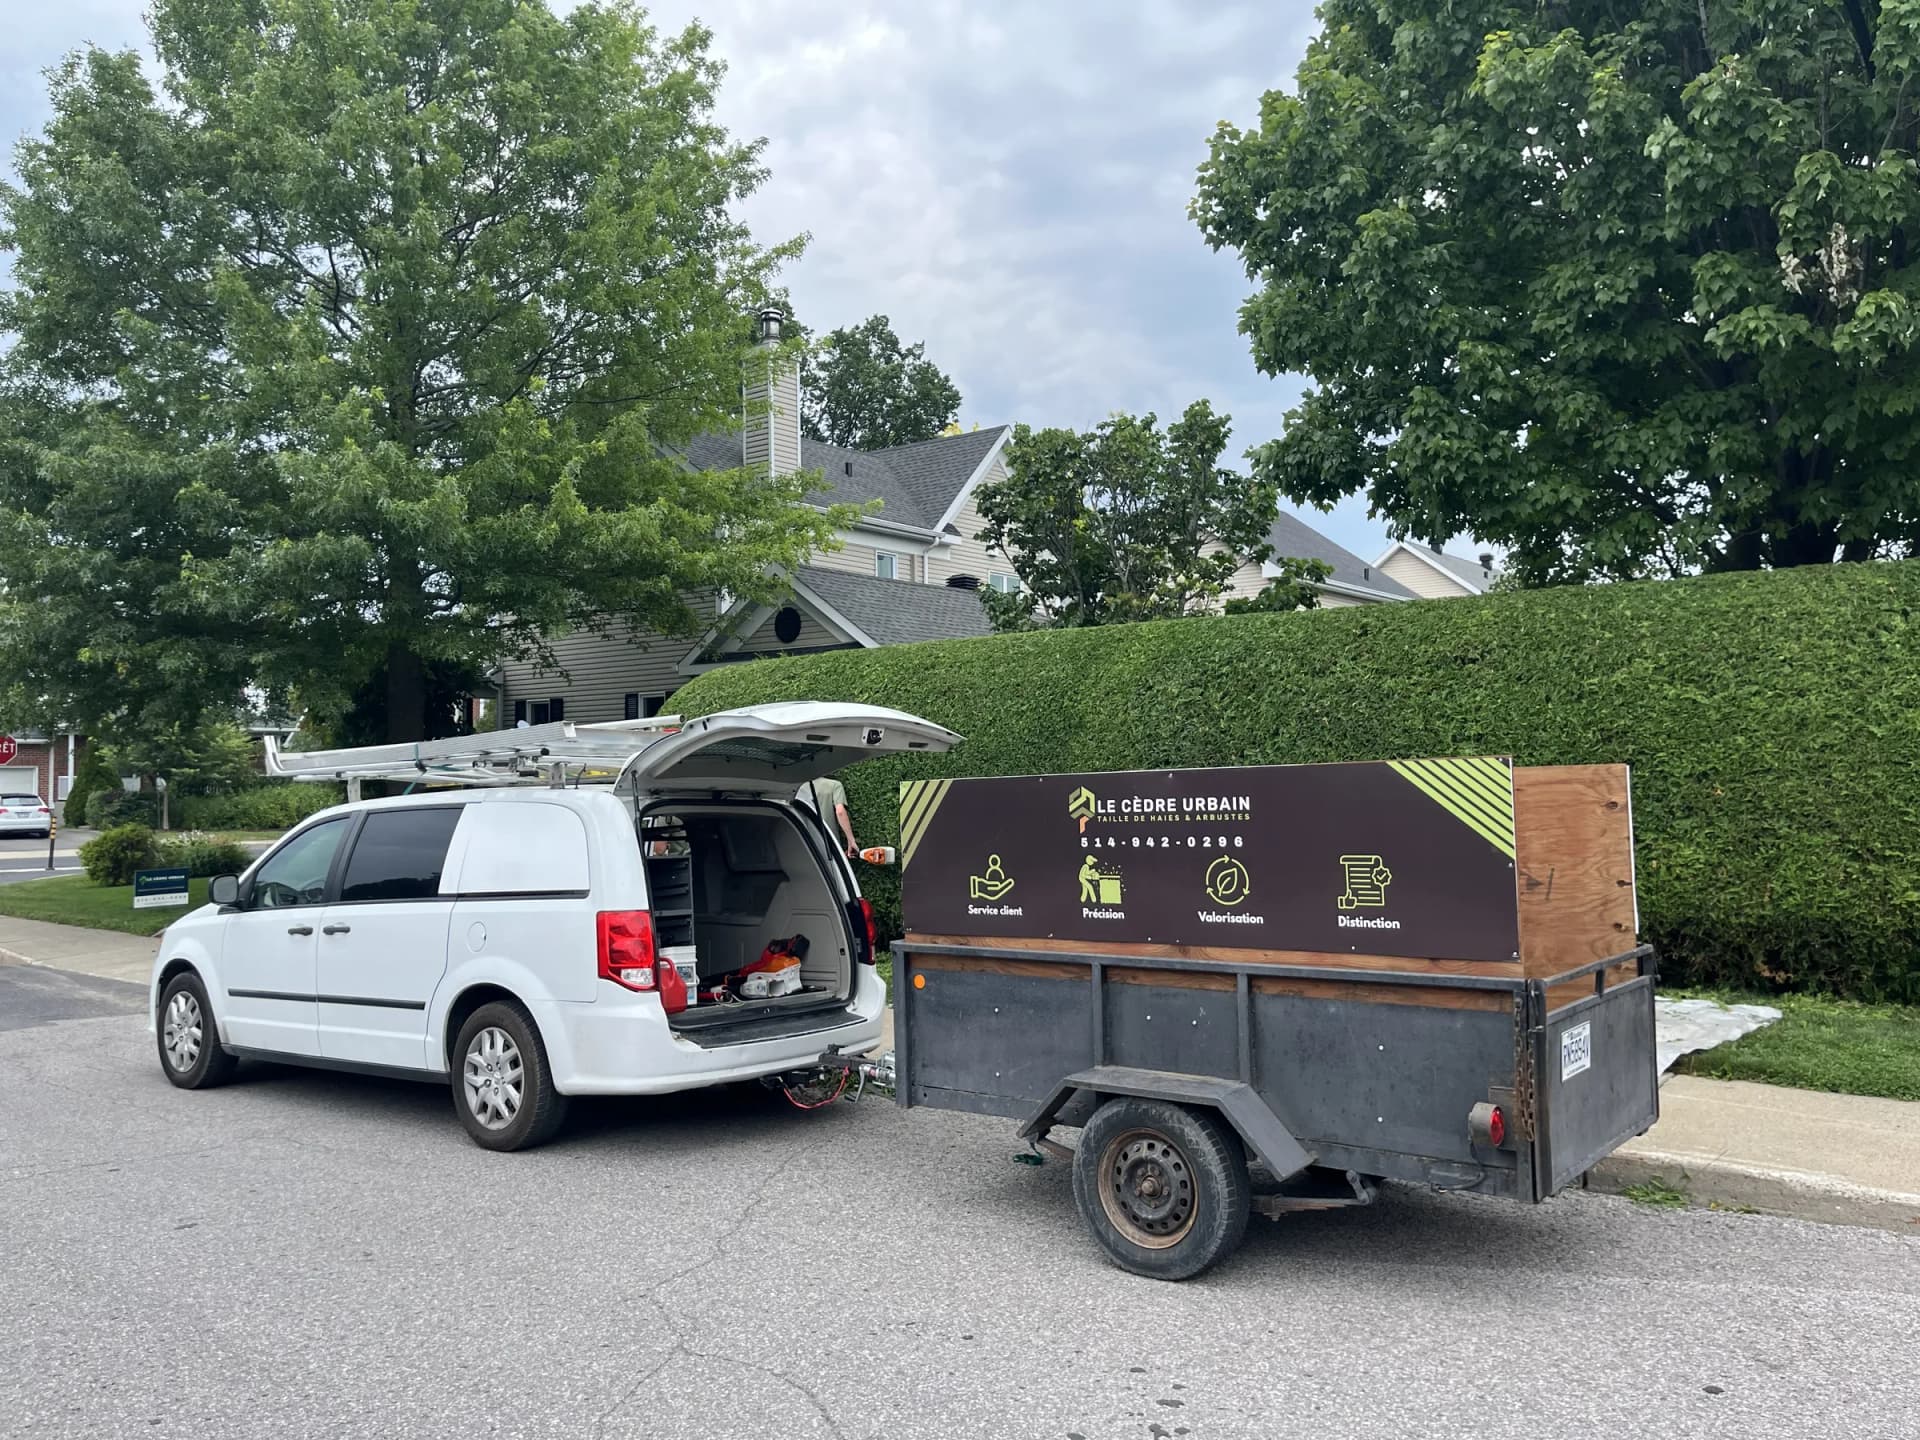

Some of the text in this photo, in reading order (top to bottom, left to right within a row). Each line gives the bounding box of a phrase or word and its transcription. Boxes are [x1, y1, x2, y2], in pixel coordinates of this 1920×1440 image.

[0, 741, 15, 753] ÊT
[1097, 795, 1250, 814] LE CÈDRE URBAIN
[1097, 815, 1129, 823] TAILLE
[1150, 814, 1180, 822] HAIES
[1196, 813, 1250, 821] ARBUSTES
[1080, 836, 1243, 848] 514-942-0296
[968, 904, 1023, 916] Service client
[1082, 907, 1125, 919] Précision
[1198, 911, 1264, 924] Valorisation
[1338, 915, 1401, 929] Distinction
